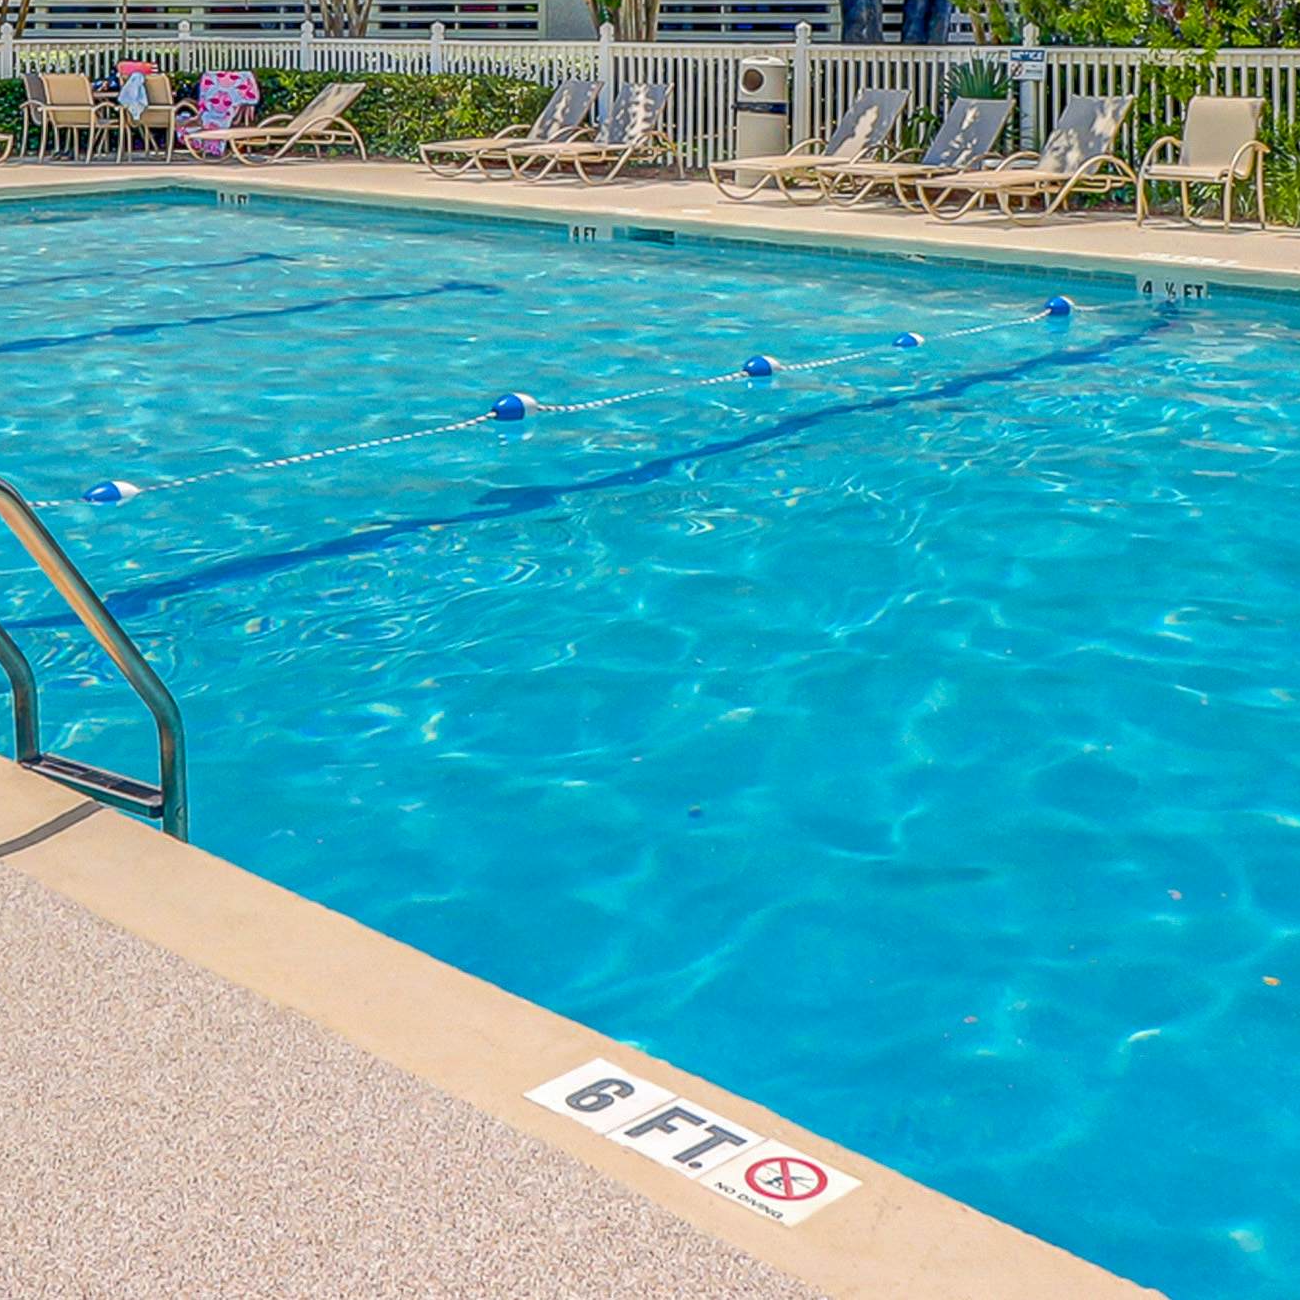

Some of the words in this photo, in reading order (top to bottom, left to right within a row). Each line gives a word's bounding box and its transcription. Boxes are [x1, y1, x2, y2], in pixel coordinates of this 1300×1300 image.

[1183, 284, 1204, 298] FT
[565, 1078, 635, 1113] 6
[623, 1105, 748, 1169] FT.
[714, 1181, 736, 1195] NO
[737, 1193, 784, 1220] DIVING
